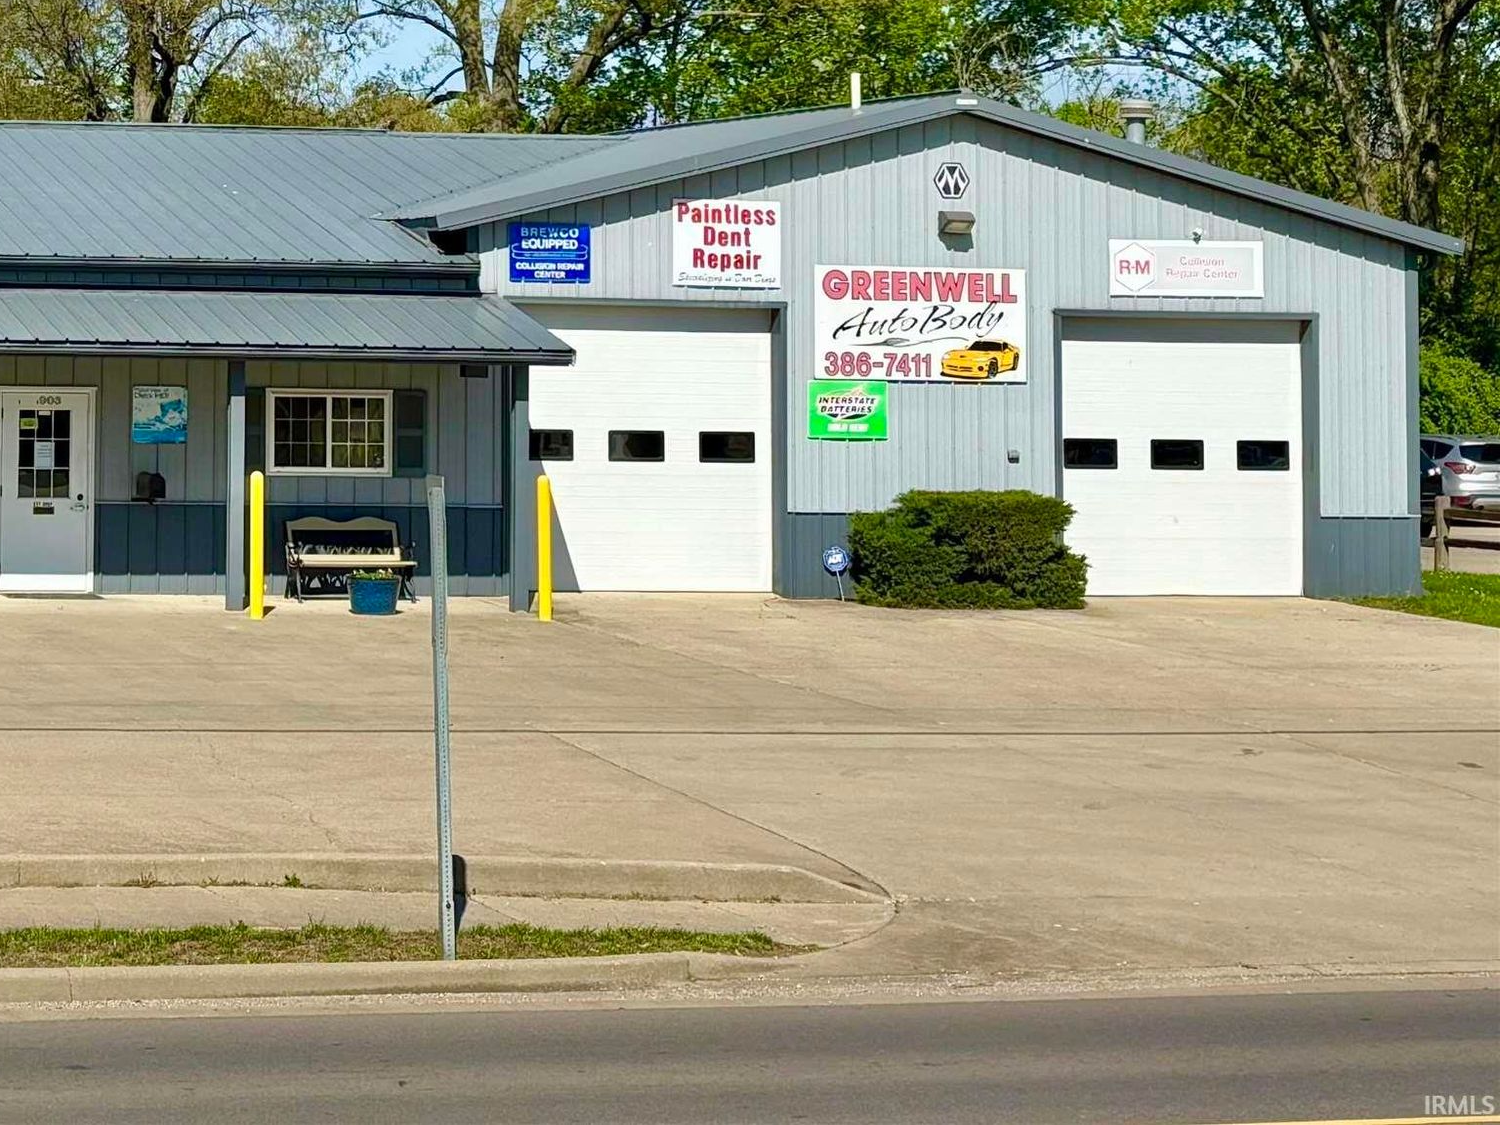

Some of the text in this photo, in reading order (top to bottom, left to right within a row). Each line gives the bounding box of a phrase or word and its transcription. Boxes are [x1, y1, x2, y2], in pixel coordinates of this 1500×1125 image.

[677, 202, 776, 226] Paintless
[521, 238, 578, 250] EQUIPPED
[703, 226, 751, 247] Dent
[693, 248, 762, 272] Repair
[1203, 268, 1238, 278] Center
[822, 269, 1017, 303] GREENWELL
[824, 351, 932, 377] 386-7411
[818, 396, 876, 404] INTERSTATE
[820, 405, 872, 413] BATTERIES
